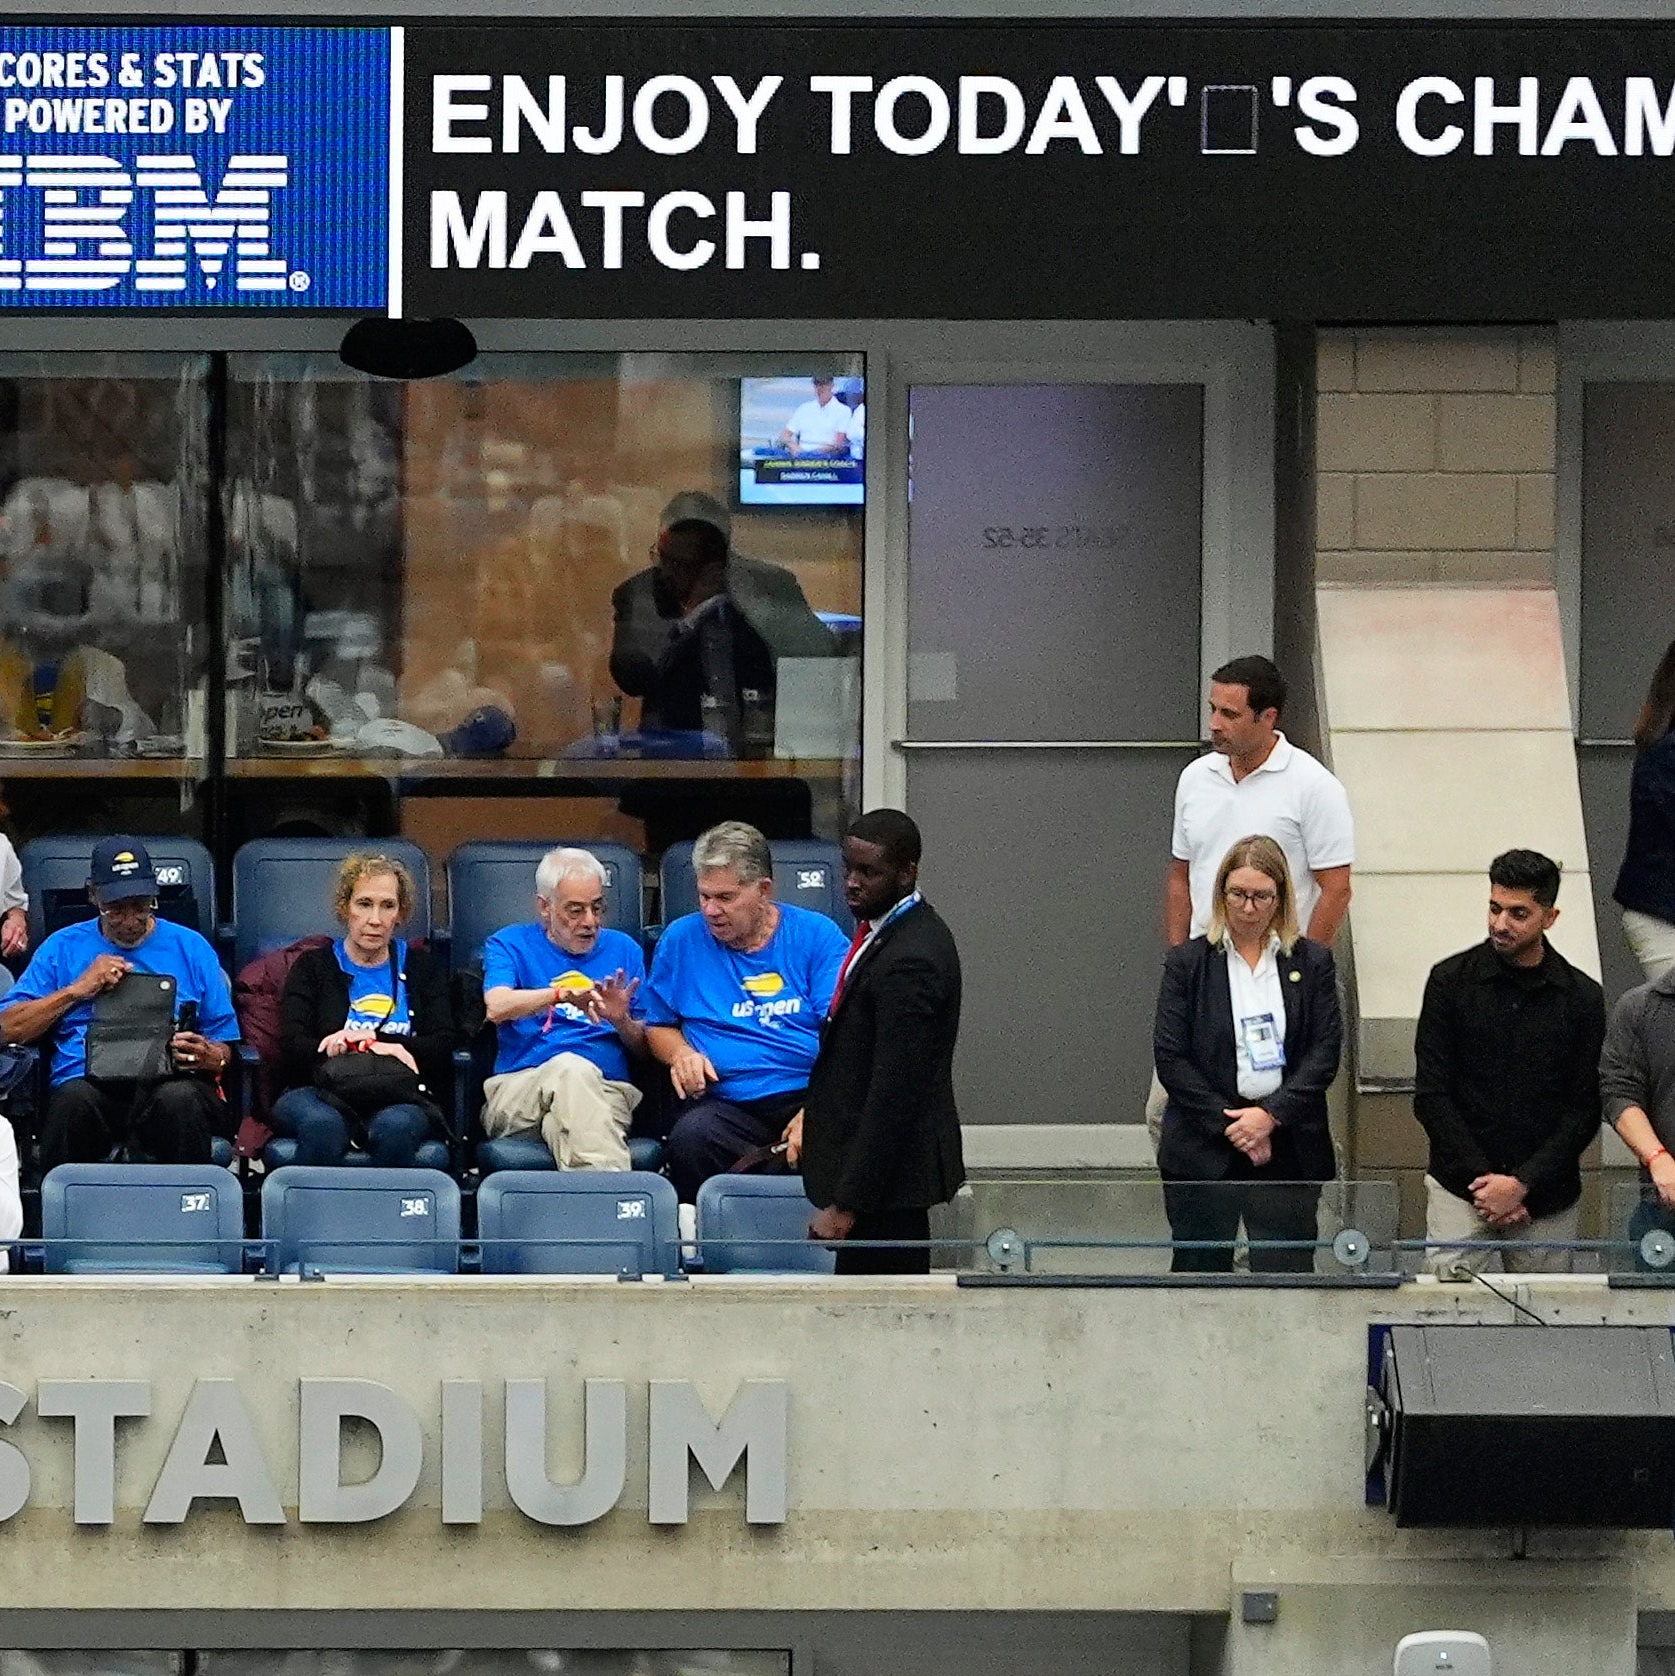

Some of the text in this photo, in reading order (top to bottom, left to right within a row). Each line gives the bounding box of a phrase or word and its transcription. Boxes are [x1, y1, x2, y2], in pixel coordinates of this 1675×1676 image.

[118, 53, 142, 88] &
[153, 53, 266, 88] STATS
[4, 98, 233, 134] POWERED BY
[433, 74, 783, 155] ENJOY
[429, 190, 821, 270] MATCH.
[157, 867, 179, 884] 49
[185, 1195, 206, 1211] 37
[405, 1199, 425, 1215] 38
[620, 1201, 642, 1218] 39
